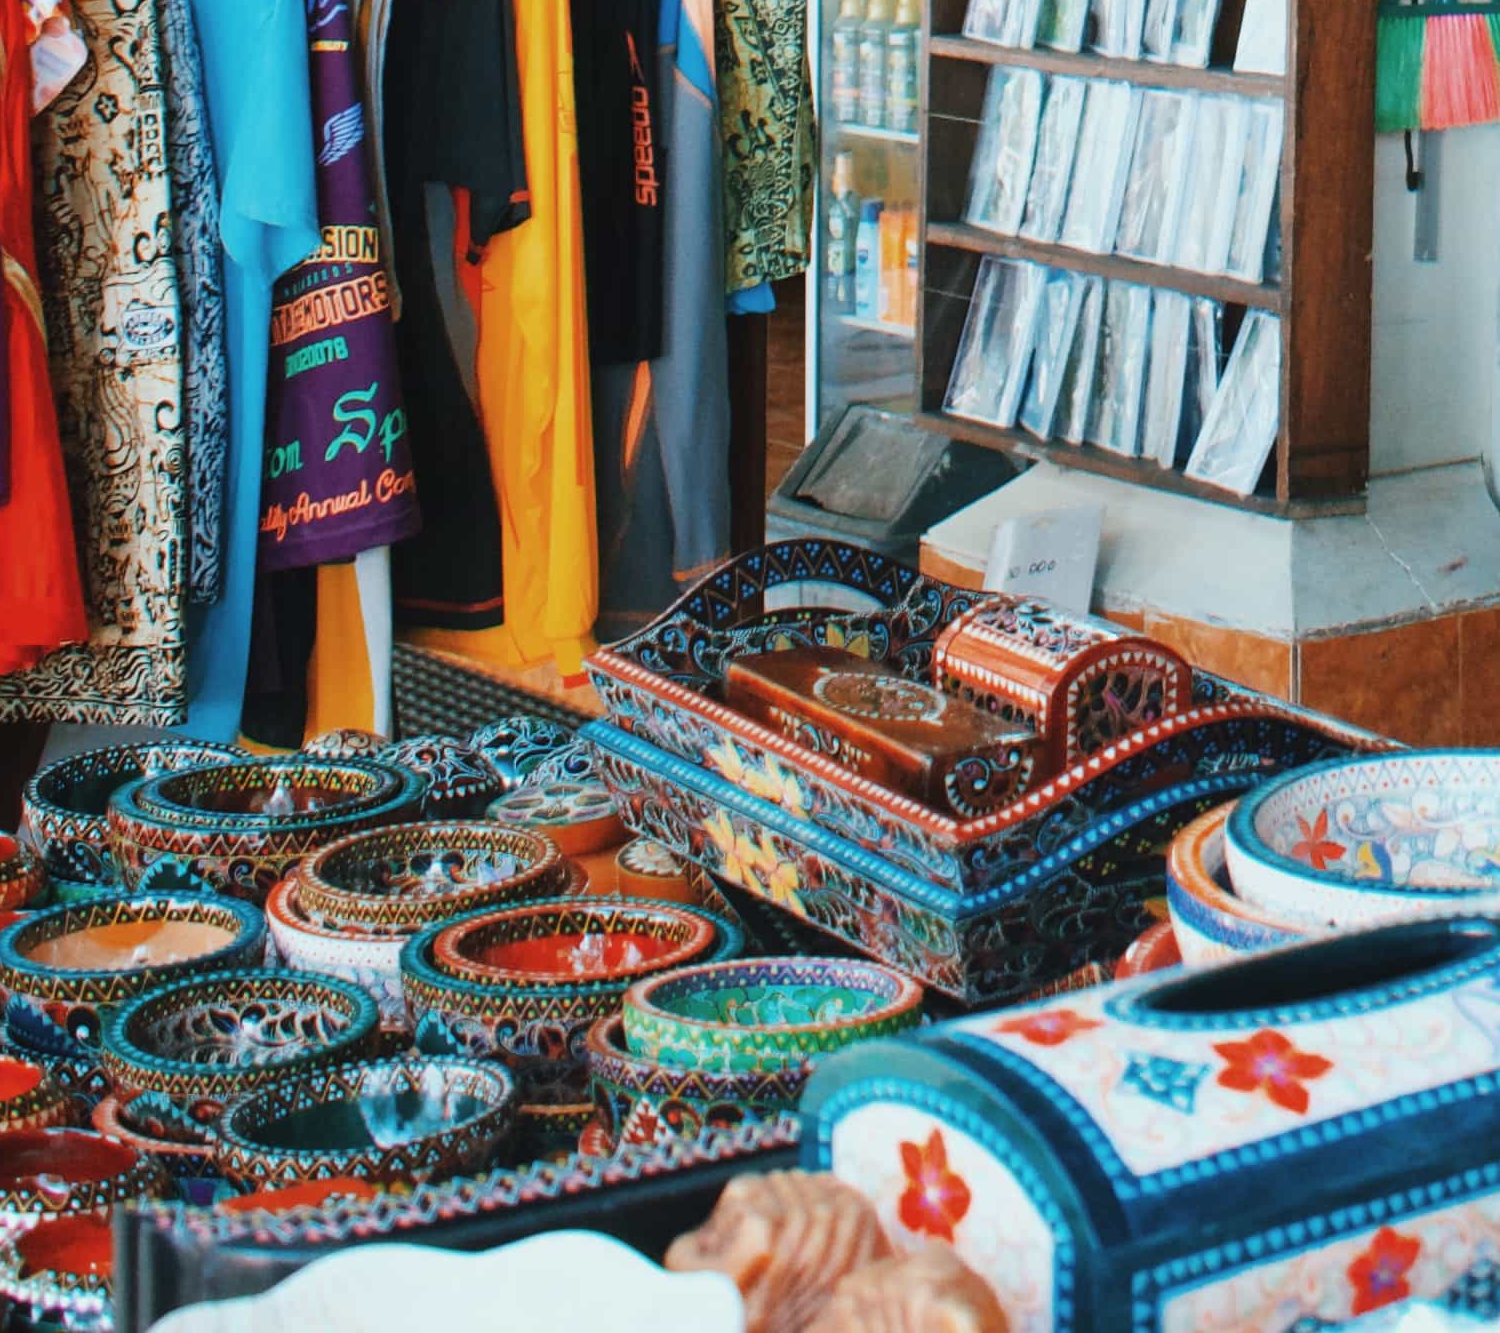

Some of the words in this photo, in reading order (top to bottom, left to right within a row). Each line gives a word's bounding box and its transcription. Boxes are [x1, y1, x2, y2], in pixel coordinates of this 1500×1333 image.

[631, 85, 660, 207] speedo
[305, 226, 378, 264] SION
[288, 478, 372, 525] Annual
